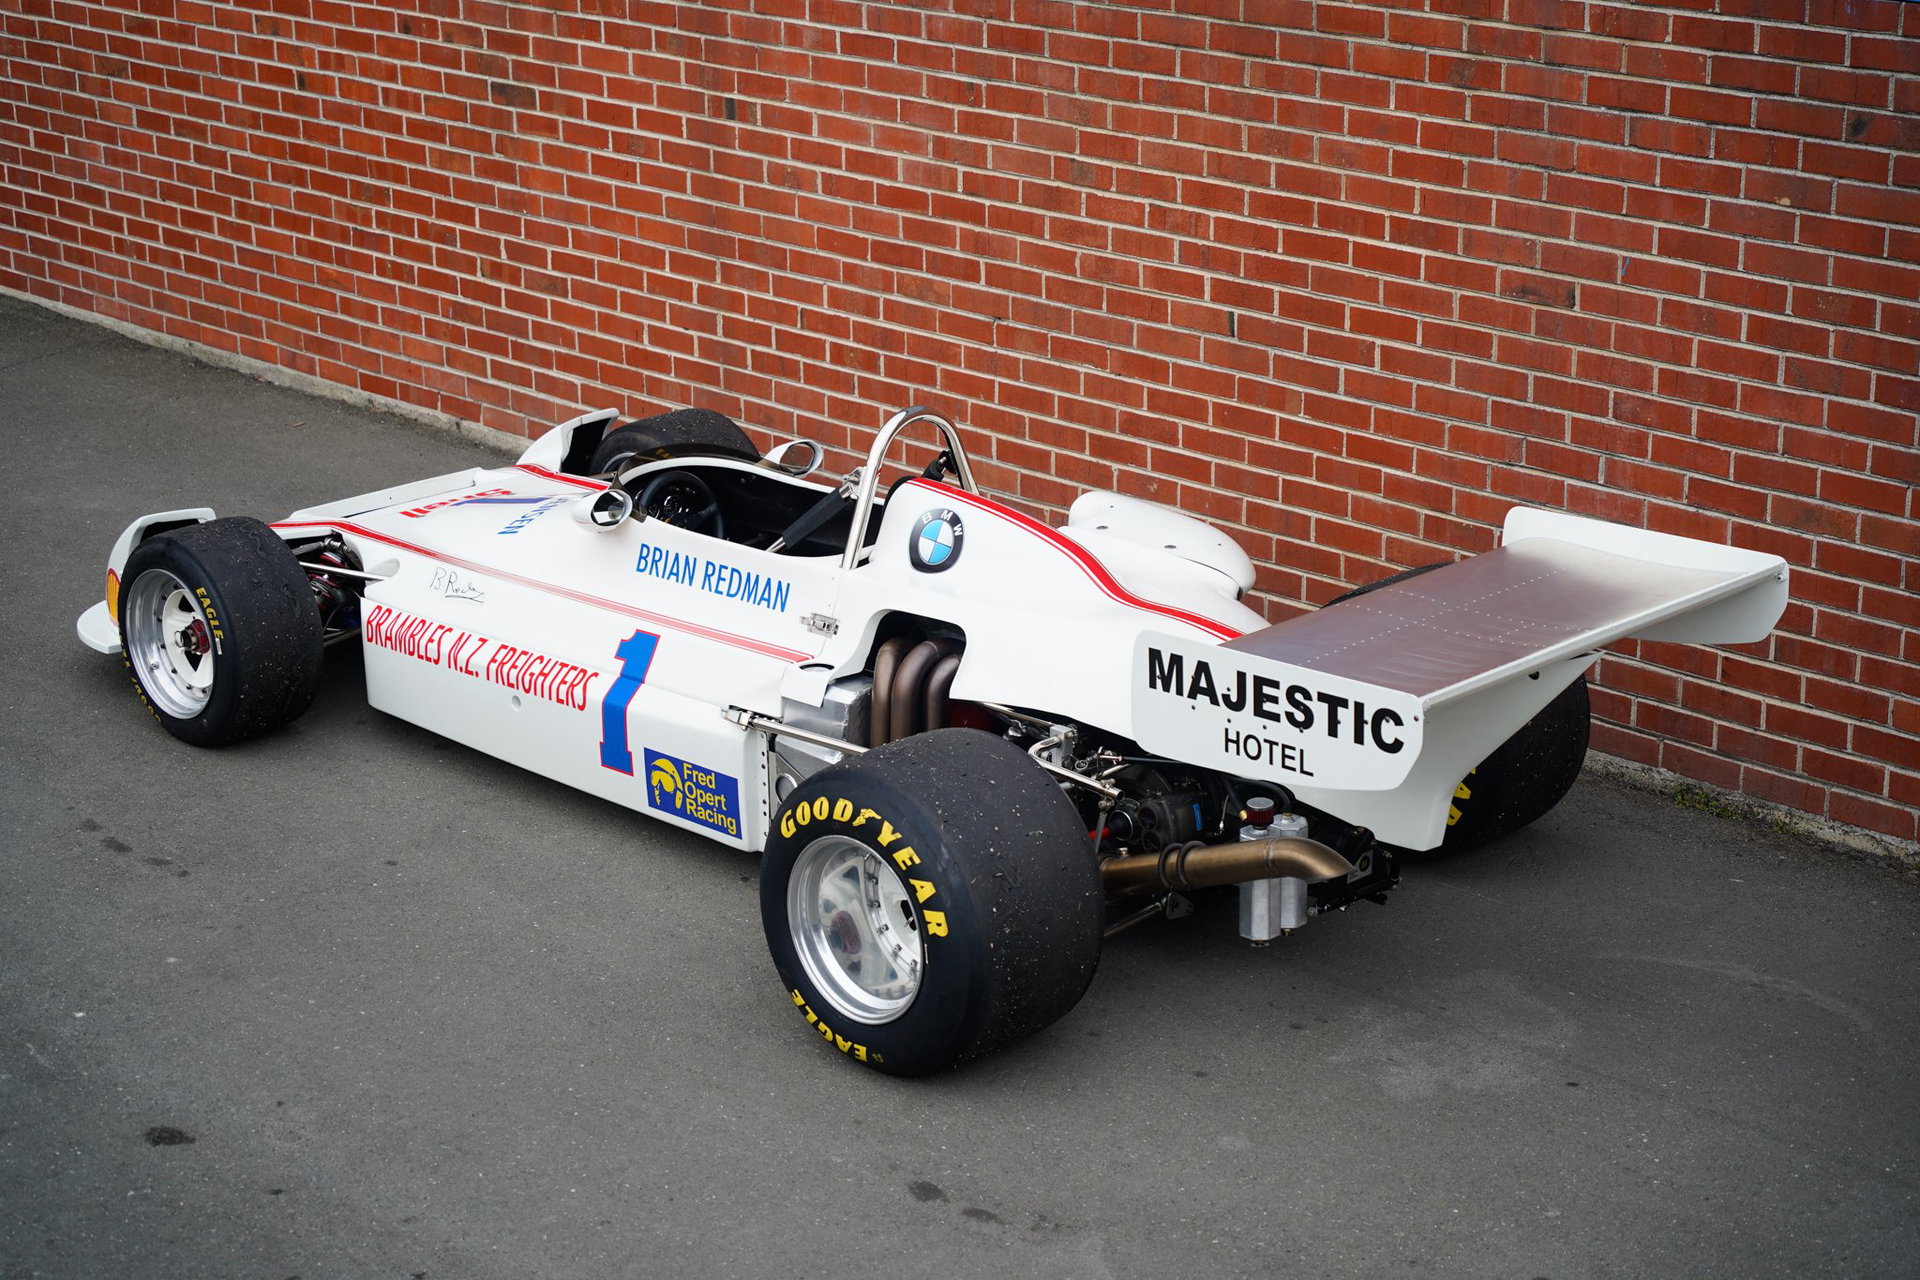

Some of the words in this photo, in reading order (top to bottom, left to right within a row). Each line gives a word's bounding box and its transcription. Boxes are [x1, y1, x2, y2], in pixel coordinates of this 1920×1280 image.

[922, 509, 963, 537] BMW
[635, 543, 697, 587] BRIAN
[701, 560, 790, 613] REDMAN
[195, 587, 224, 640] EAGLE
[366, 605, 453, 666] BRAMBLES
[448, 632, 489, 678] N.Z.
[487, 644, 599, 712] FREIGHTERS
[600, 628, 660, 777] 1
[1147, 646, 1405, 754] MAJESTIC
[683, 762, 716, 790] Fred
[1224, 727, 1315, 777] HOTEL
[684, 781, 727, 811] Opert
[686, 798, 737, 835] Racing
[780, 796, 949, 938] GOODYEAR
[791, 988, 867, 1062] EAGLE
